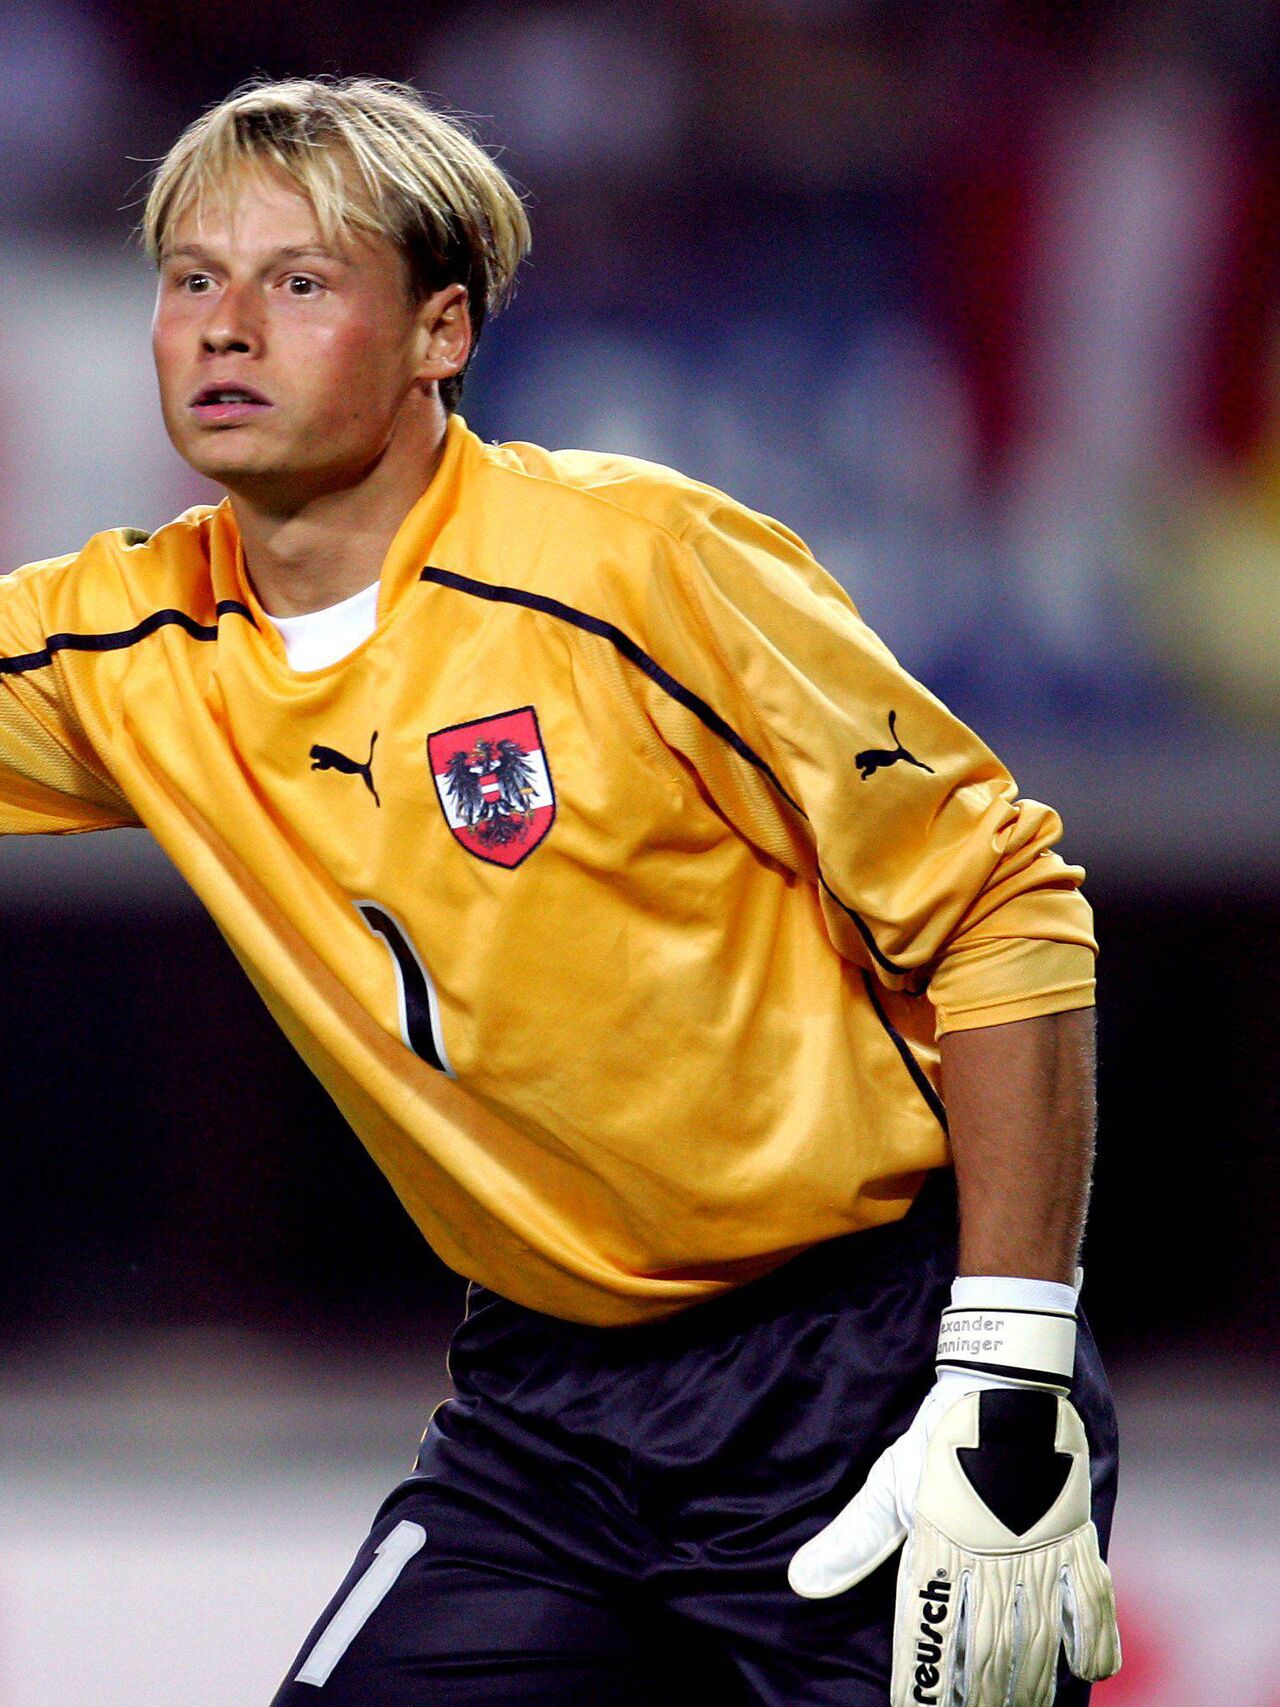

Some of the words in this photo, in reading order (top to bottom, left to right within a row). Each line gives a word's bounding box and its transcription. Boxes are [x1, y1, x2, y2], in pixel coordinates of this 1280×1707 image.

[352, 899, 458, 1080] 1
[937, 1337, 1004, 1355] anninger
[941, 1316, 1005, 1334] exander
[294, 1519, 427, 1687] 1
[913, 1579, 952, 1707] reusch
